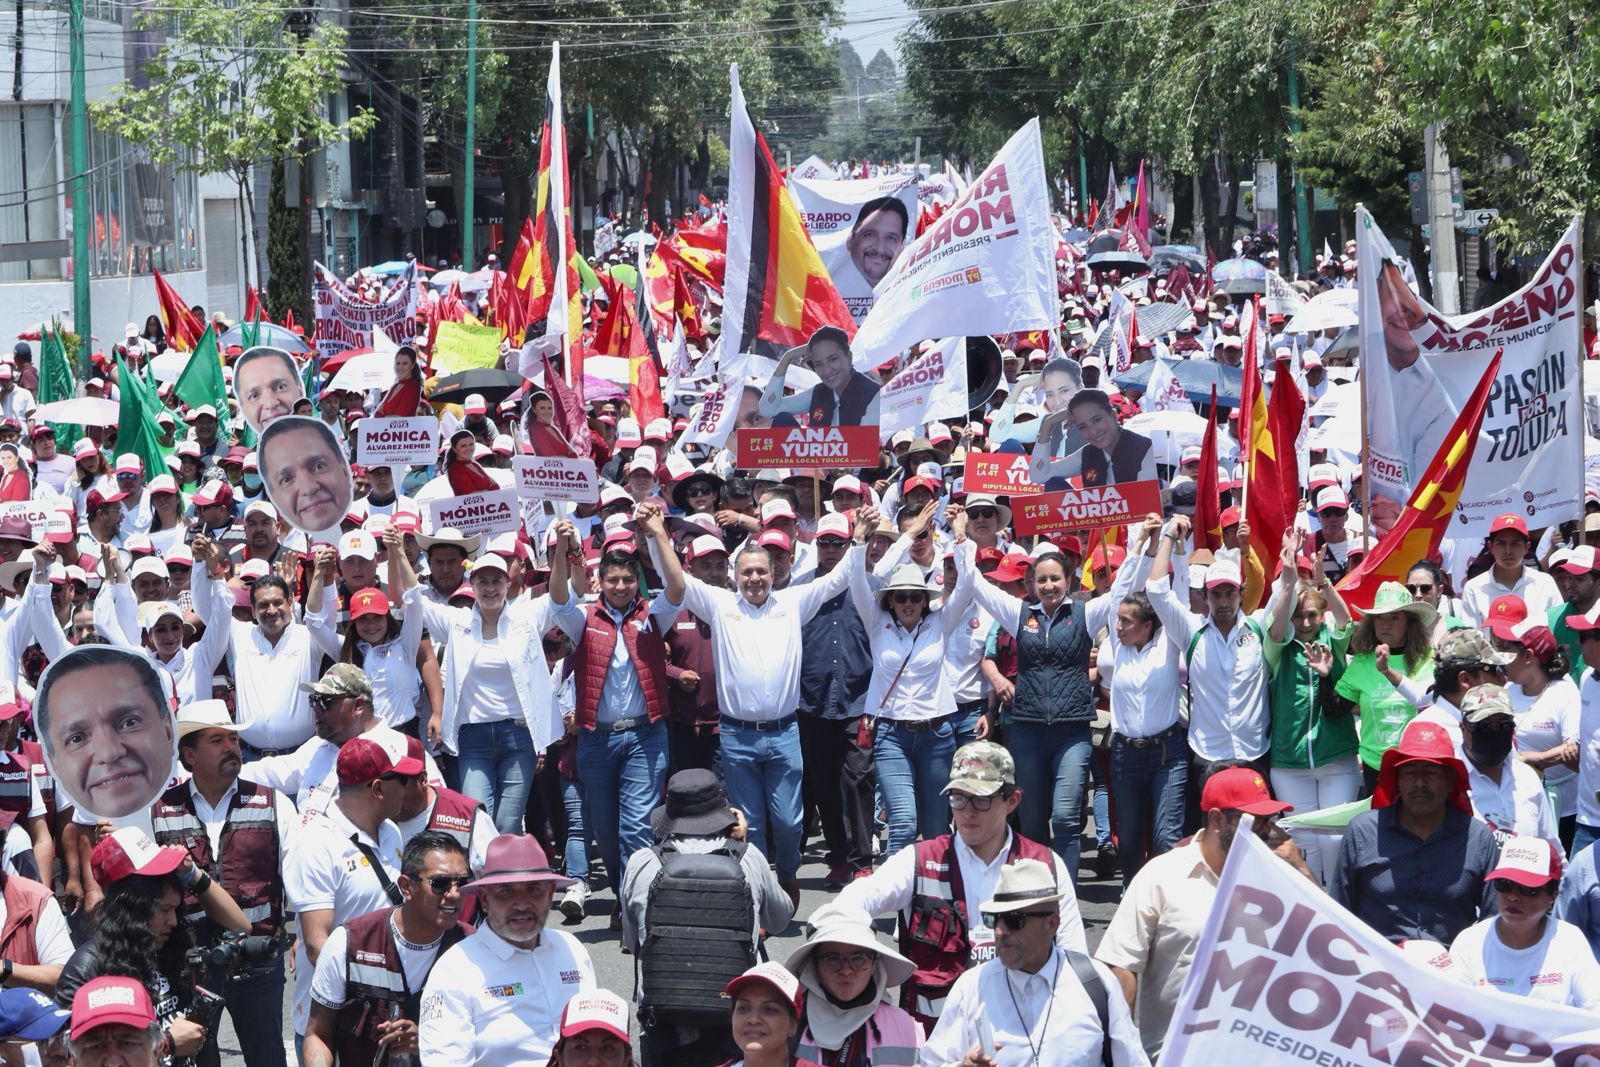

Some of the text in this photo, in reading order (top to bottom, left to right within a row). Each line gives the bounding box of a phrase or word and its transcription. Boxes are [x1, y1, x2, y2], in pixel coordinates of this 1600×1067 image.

[800, 212, 852, 222] ERARDO
[804, 222, 838, 230] PLIEGO
[316, 319, 365, 349] RICARDO
[1507, 323, 1555, 344] MUNICIP
[366, 429, 430, 442] MÓNICA
[786, 428, 844, 442] ANA
[1486, 400, 1568, 463] TOLUCA
[367, 443, 402, 451] ÁLVAREZ
[781, 443, 848, 457] YURIXI
[522, 467, 588, 481] MÓNICA
[1369, 456, 1402, 478] orena
[524, 480, 560, 488] ÁLVAREZ
[983, 484, 1017, 492] DIPUTADA
[1060, 487, 1121, 506] ANA
[439, 502, 510, 521] MÓNICA
[1057, 500, 1128, 520] YURIXI
[482, 513, 511, 523] NEMER
[1036, 521, 1073, 530] DIPUTADA
[1075, 518, 1100, 526] LOCAL
[1102, 514, 1131, 523] TOLUCA
[436, 814, 470, 826] morena
[970, 946, 996, 960] STAF
[1217, 884, 1600, 1067] RICARD
[154, 995, 179, 1017] KEEP
[579, 1005, 618, 1015] MORENO
[580, 999, 619, 1010] RICARDO
